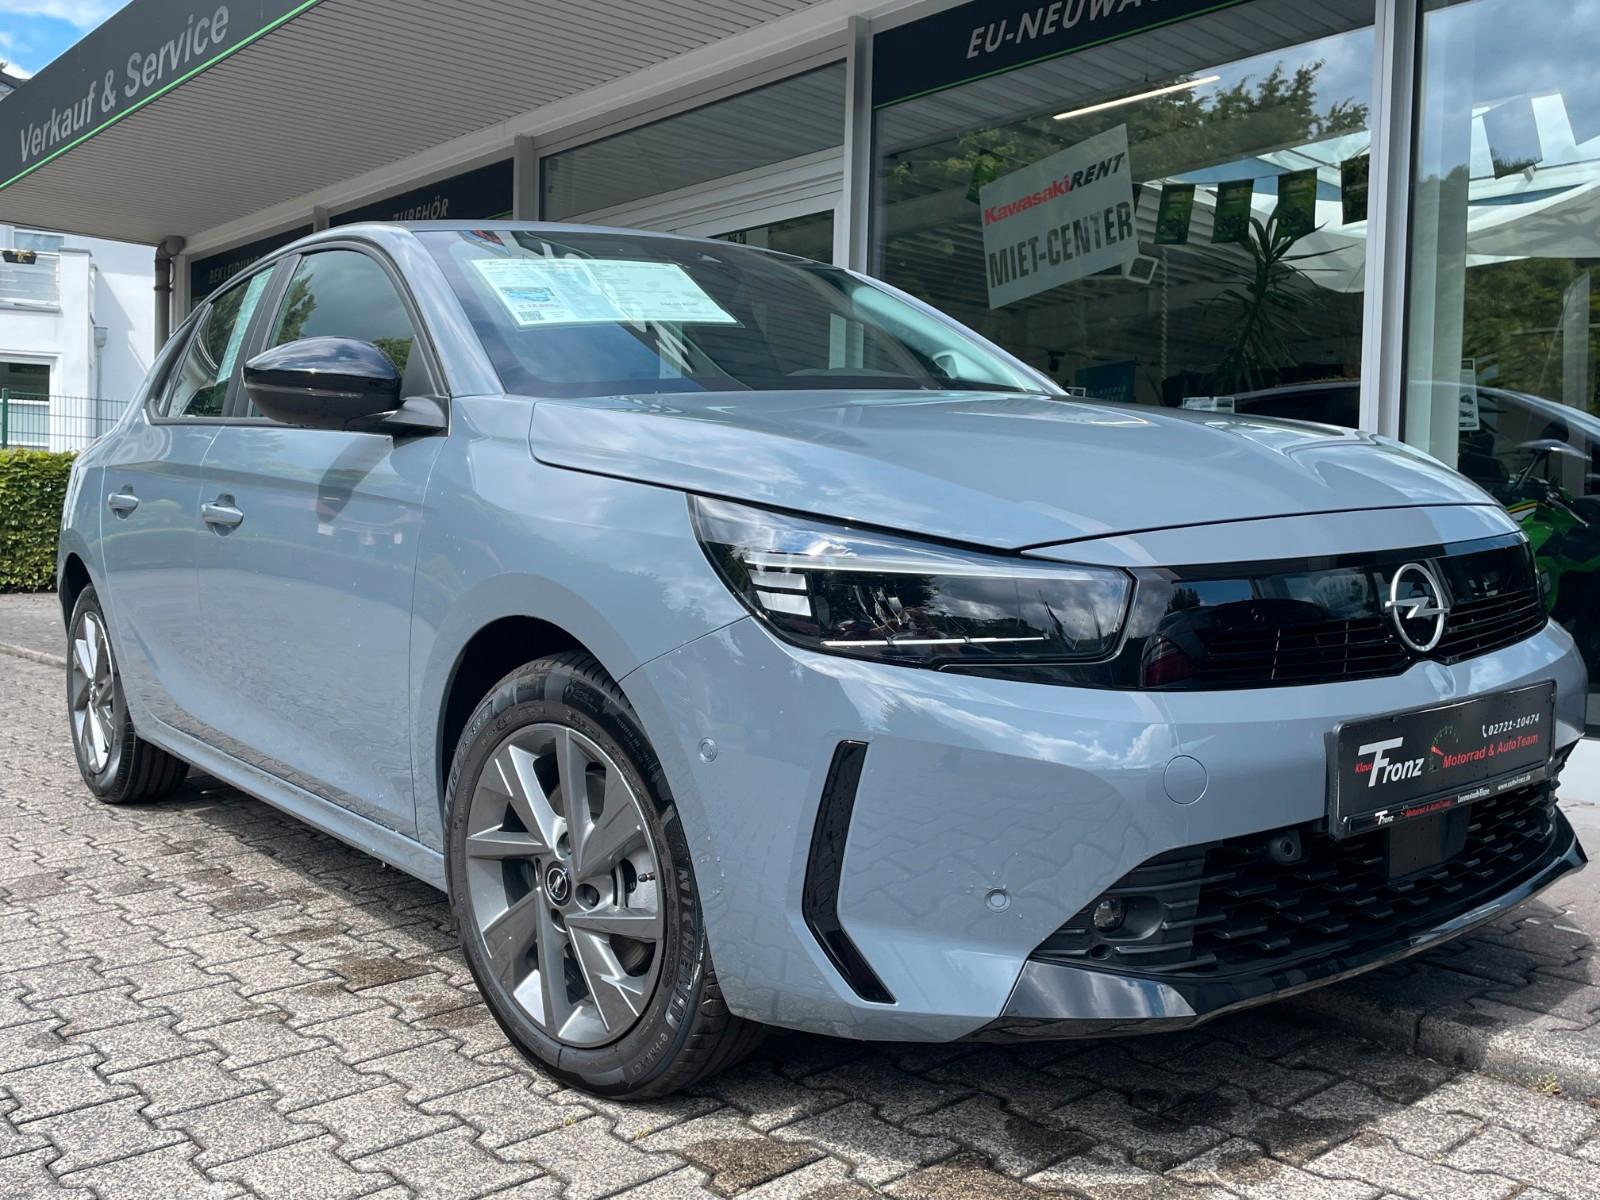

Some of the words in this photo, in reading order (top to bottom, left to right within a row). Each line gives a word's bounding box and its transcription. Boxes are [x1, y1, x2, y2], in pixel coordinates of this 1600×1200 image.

[20, 81, 97, 163] Verkauf
[101, 69, 116, 113] &
[125, 5, 229, 98] Service
[988, 201, 1133, 288] MIET-CENTER
[1443, 746, 1485, 769] Motorrad
[1487, 744, 1495, 757] &
[1497, 734, 1539, 754] AutoTeam
[1488, 713, 1540, 736] 02721-10474
